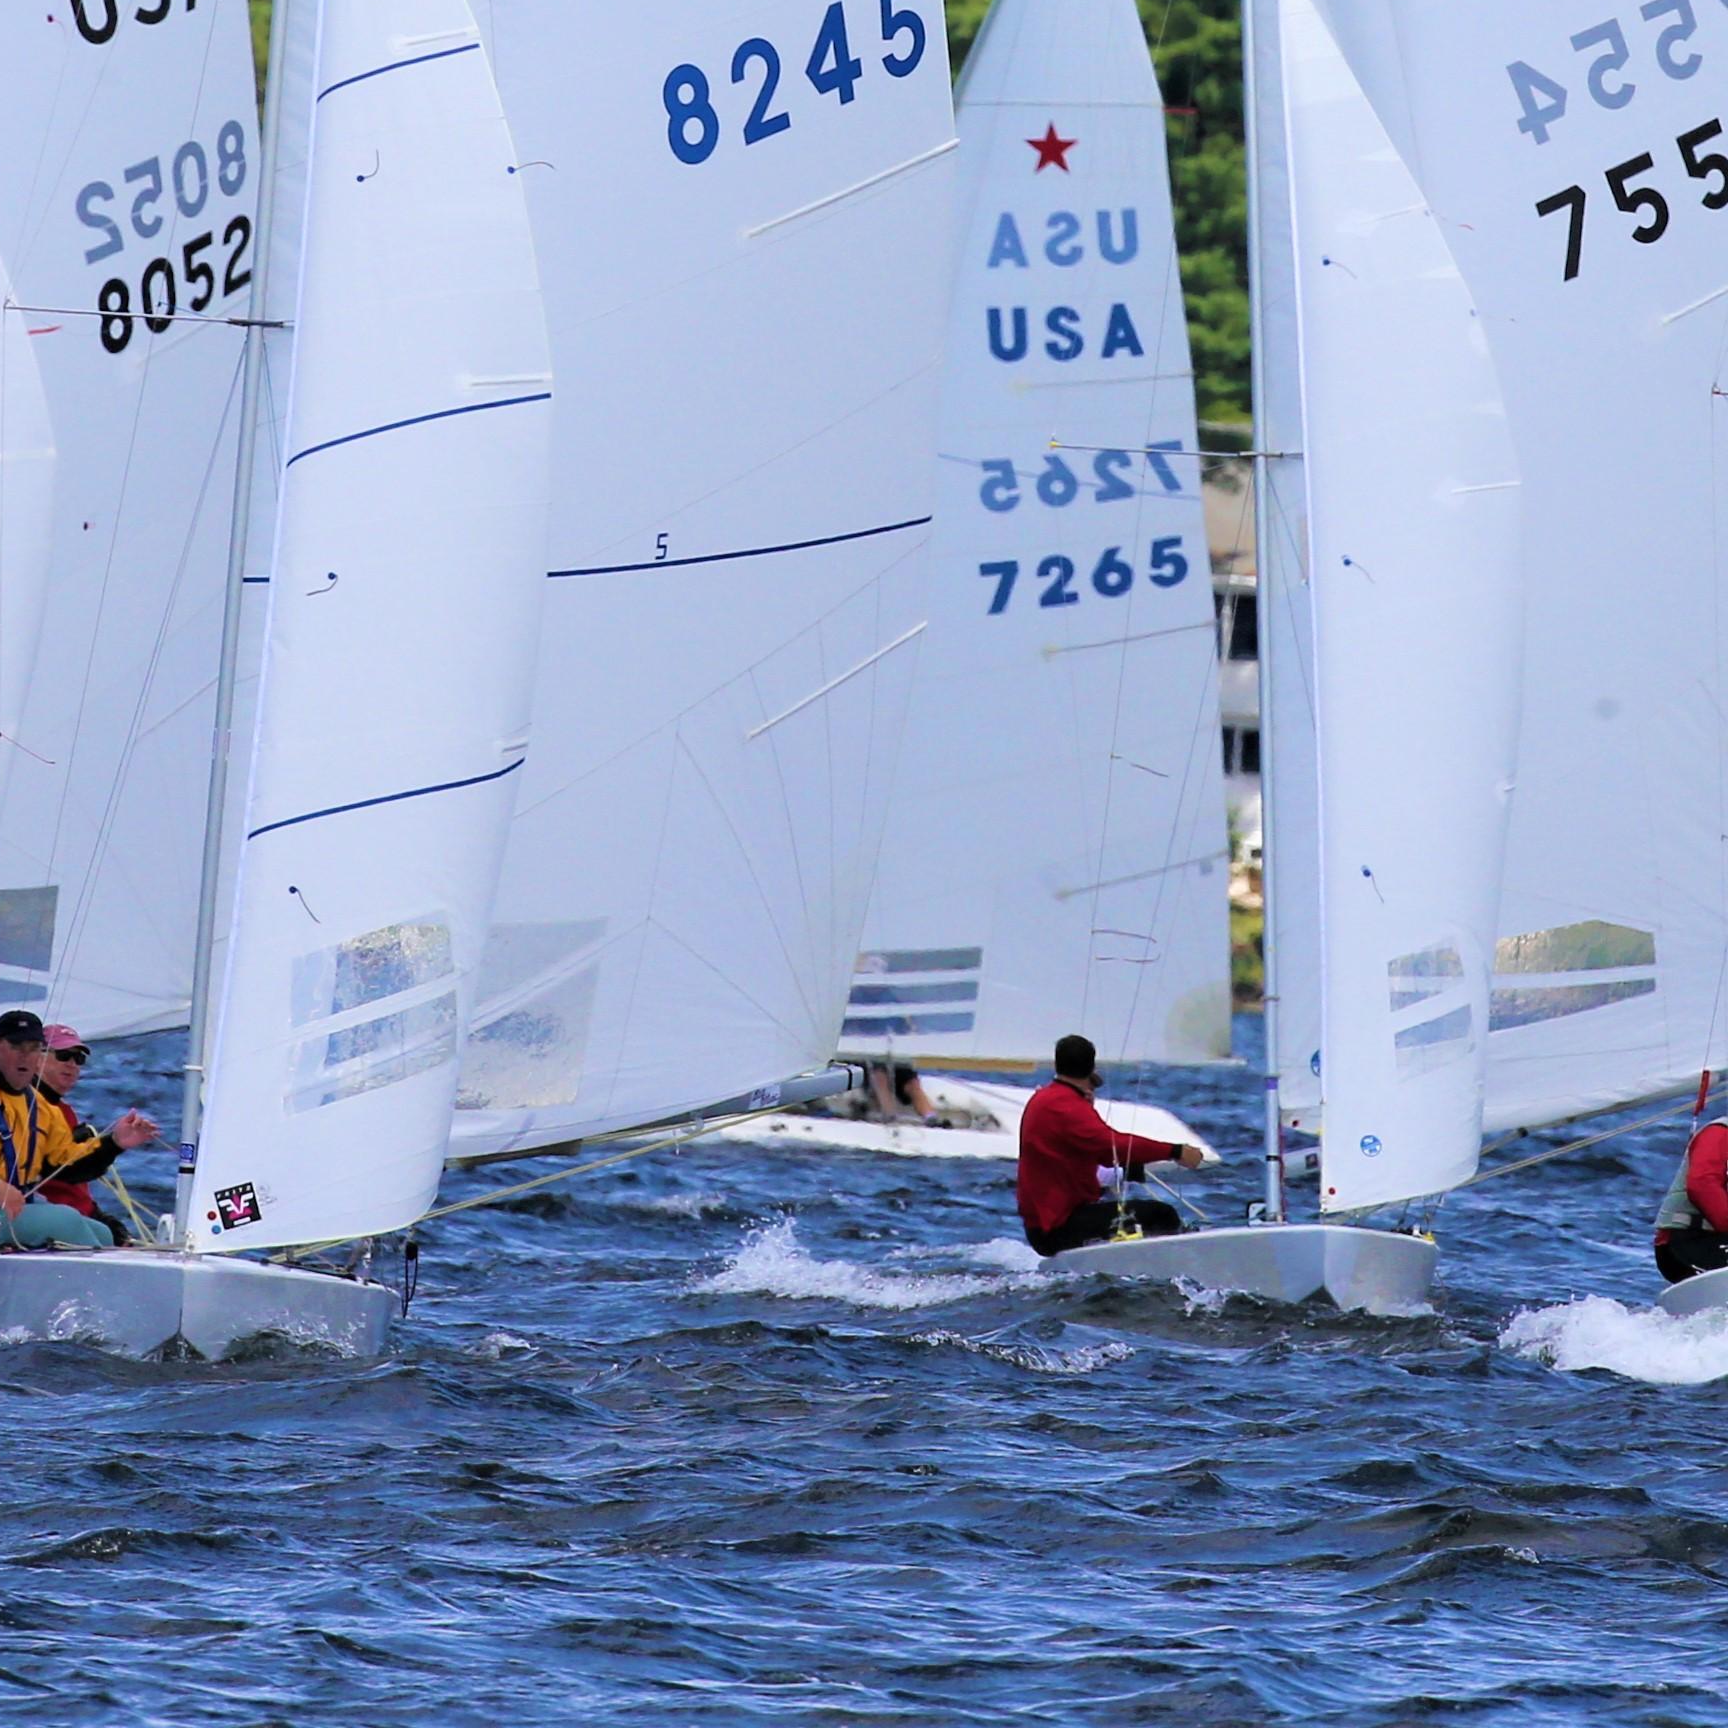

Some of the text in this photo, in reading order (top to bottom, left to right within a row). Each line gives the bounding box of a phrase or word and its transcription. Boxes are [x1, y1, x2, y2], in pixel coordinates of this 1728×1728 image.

[98, 214, 252, 355] 8052
[987, 303, 1144, 363] USA
[655, 533, 669, 560] 5
[979, 536, 1188, 616] 7265
